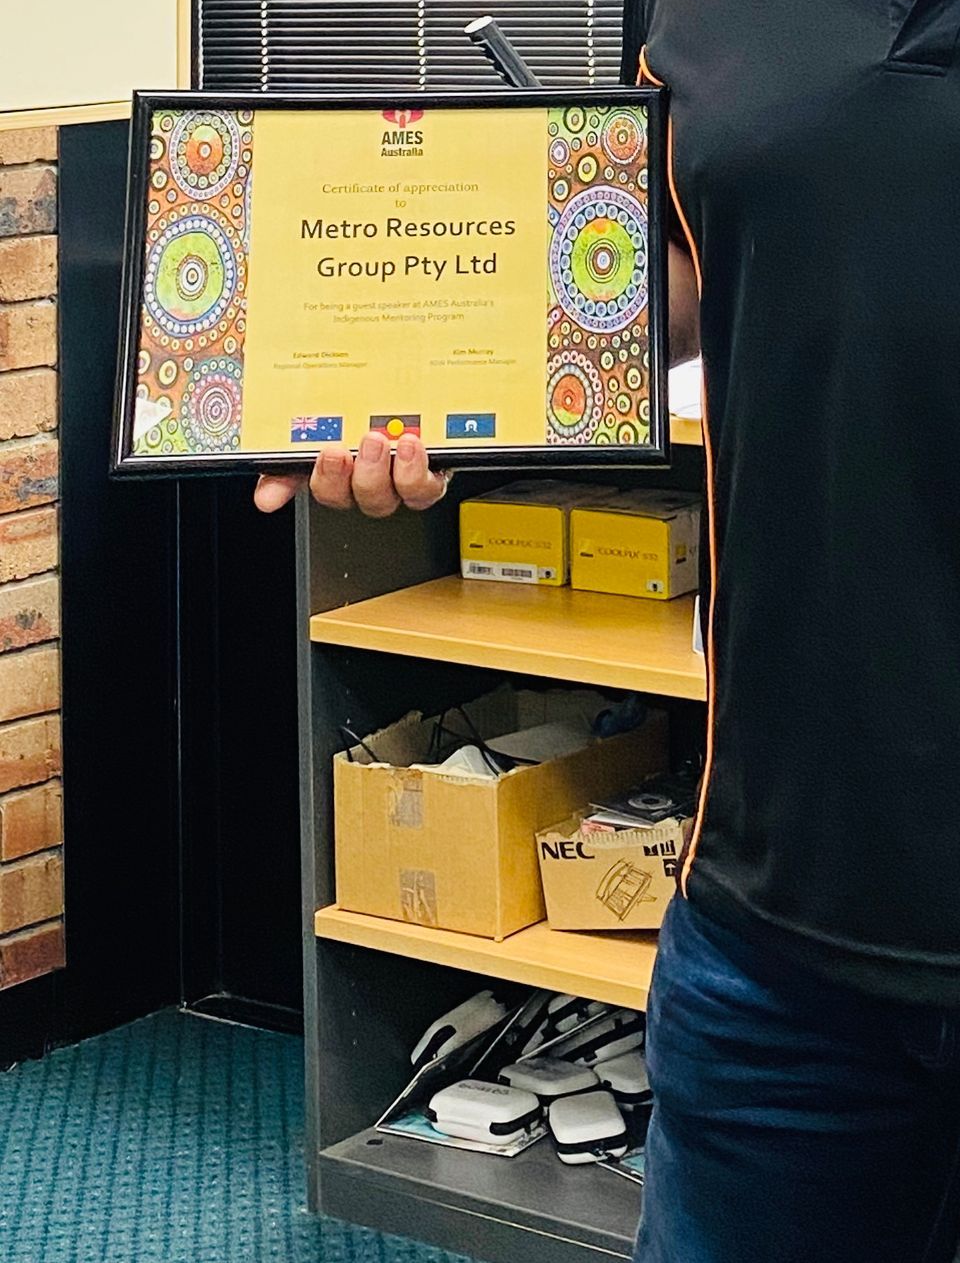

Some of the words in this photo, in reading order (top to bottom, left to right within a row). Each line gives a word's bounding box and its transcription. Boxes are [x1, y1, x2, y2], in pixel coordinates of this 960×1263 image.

[381, 130, 424, 145] AMES
[381, 147, 424, 157] Australia
[322, 182, 385, 194] Certificate
[388, 182, 400, 193] of
[404, 182, 479, 195] appreciation
[395, 198, 407, 208] to
[301, 219, 378, 239] Metro
[386, 218, 516, 237] Resources
[317, 257, 396, 282] Group
[404, 256, 447, 282] Pty
[456, 252, 497, 274] Ltd
[304, 302, 318, 311] For
[320, 301, 344, 313] being
[352, 302, 376, 312] guest
[378, 300, 409, 312] speaker
[412, 301, 421, 309] at
[423, 300, 449, 308] AMES
[450, 299, 494, 308] Australia's
[333, 314, 379, 324] Indigenous
[382, 313, 426, 323] Mentoring
[428, 312, 464, 322] Program
[488, 537, 533, 548] COOLPIX
[598, 548, 640, 560] COOLPIX
[541, 841, 595, 860] NEC
